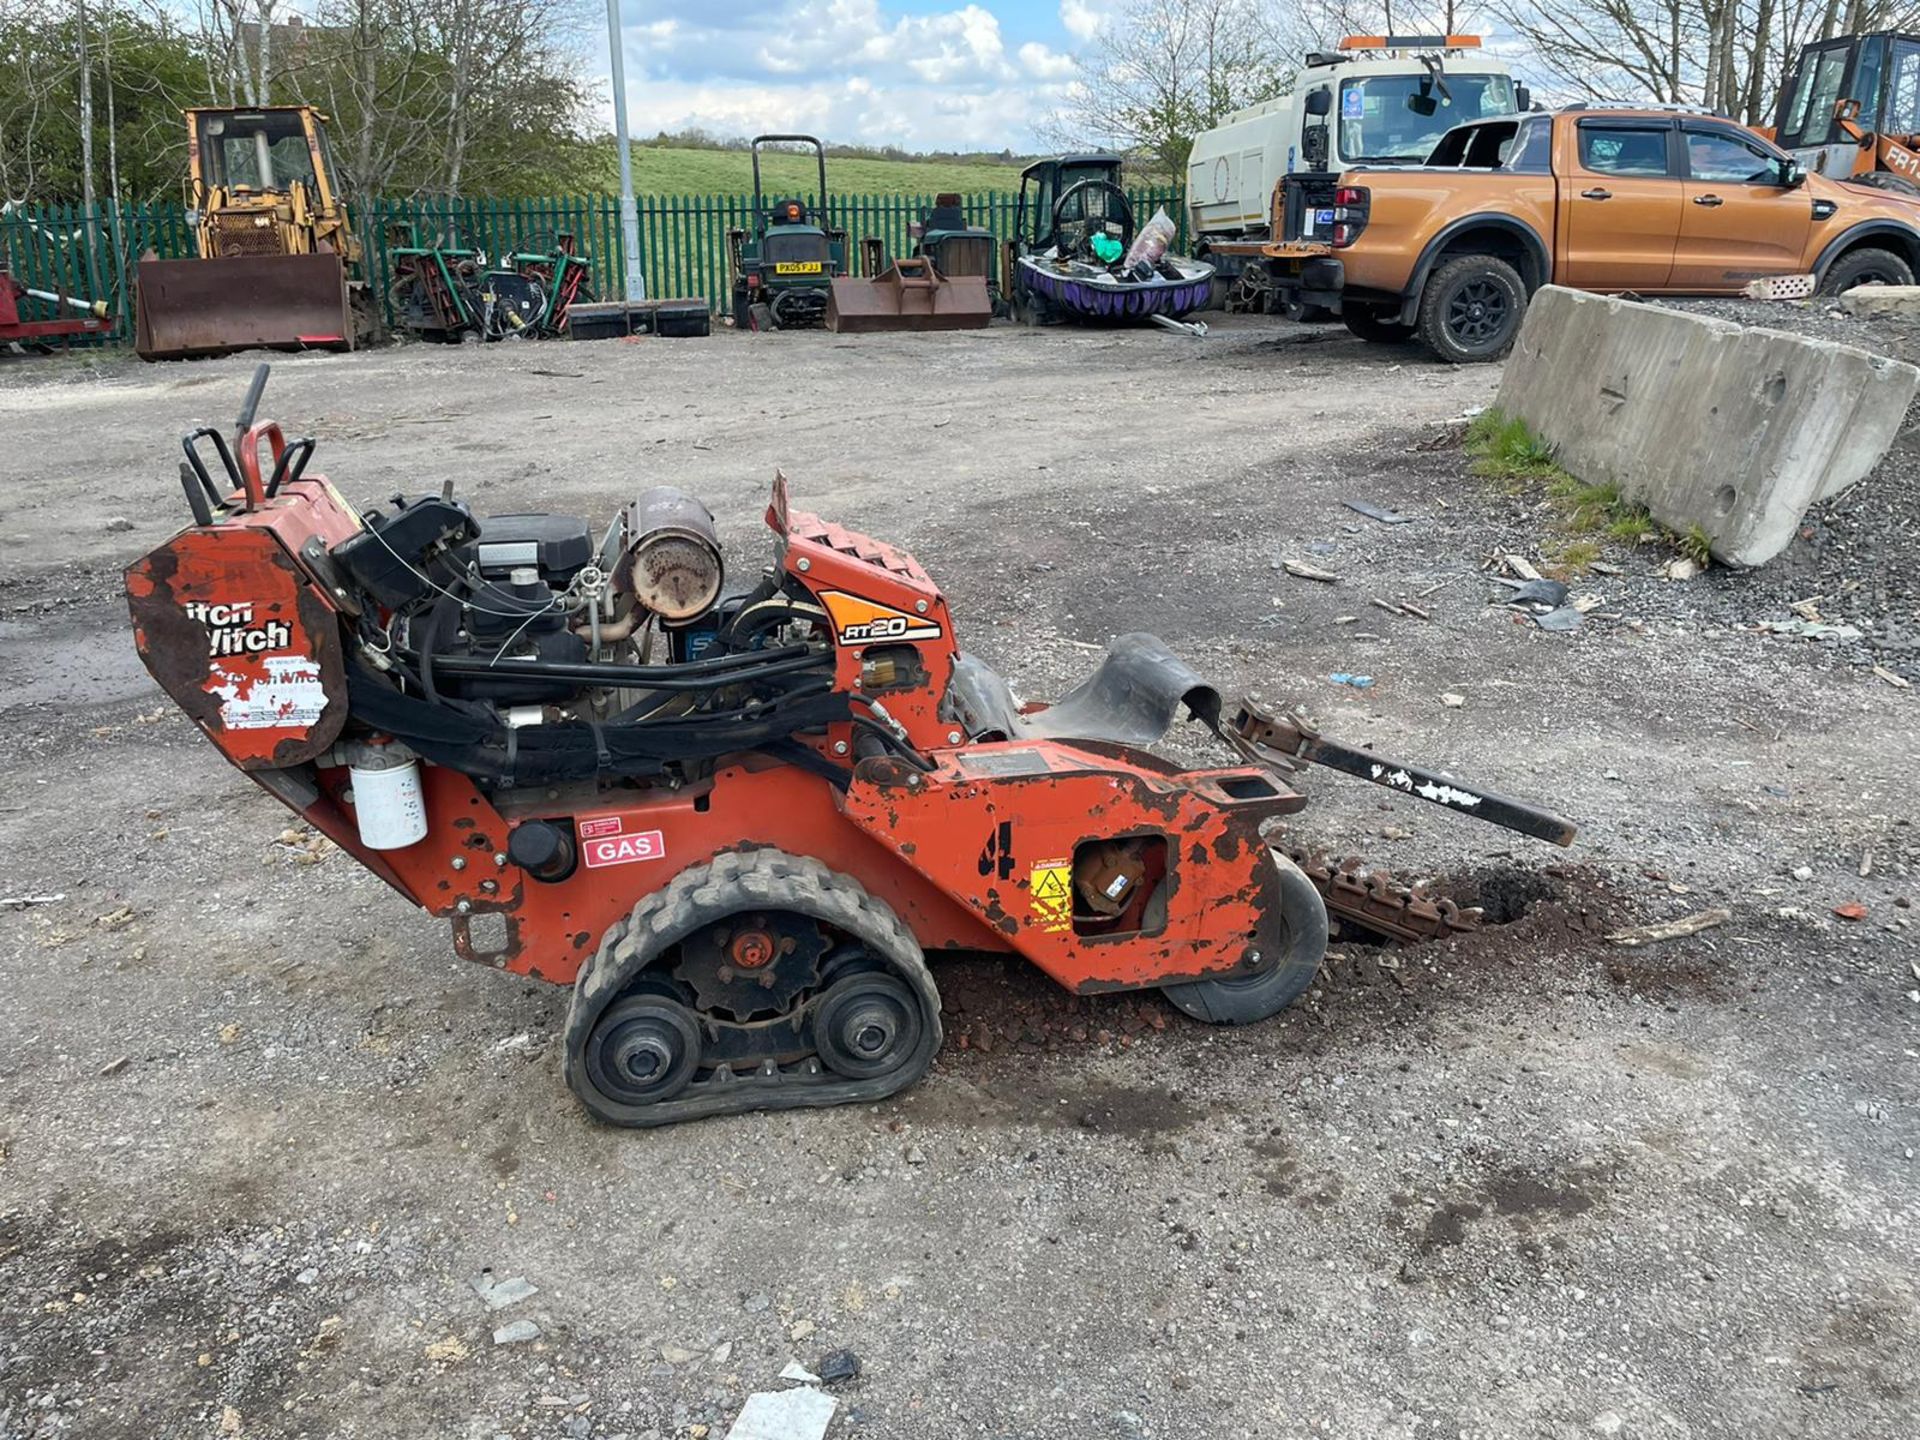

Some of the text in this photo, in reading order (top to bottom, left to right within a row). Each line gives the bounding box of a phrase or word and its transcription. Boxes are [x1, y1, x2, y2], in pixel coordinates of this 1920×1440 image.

[186, 601, 254, 626] itch
[206, 622, 290, 657] itch
[845, 618, 907, 639] RT20
[597, 838, 651, 860] GAS
